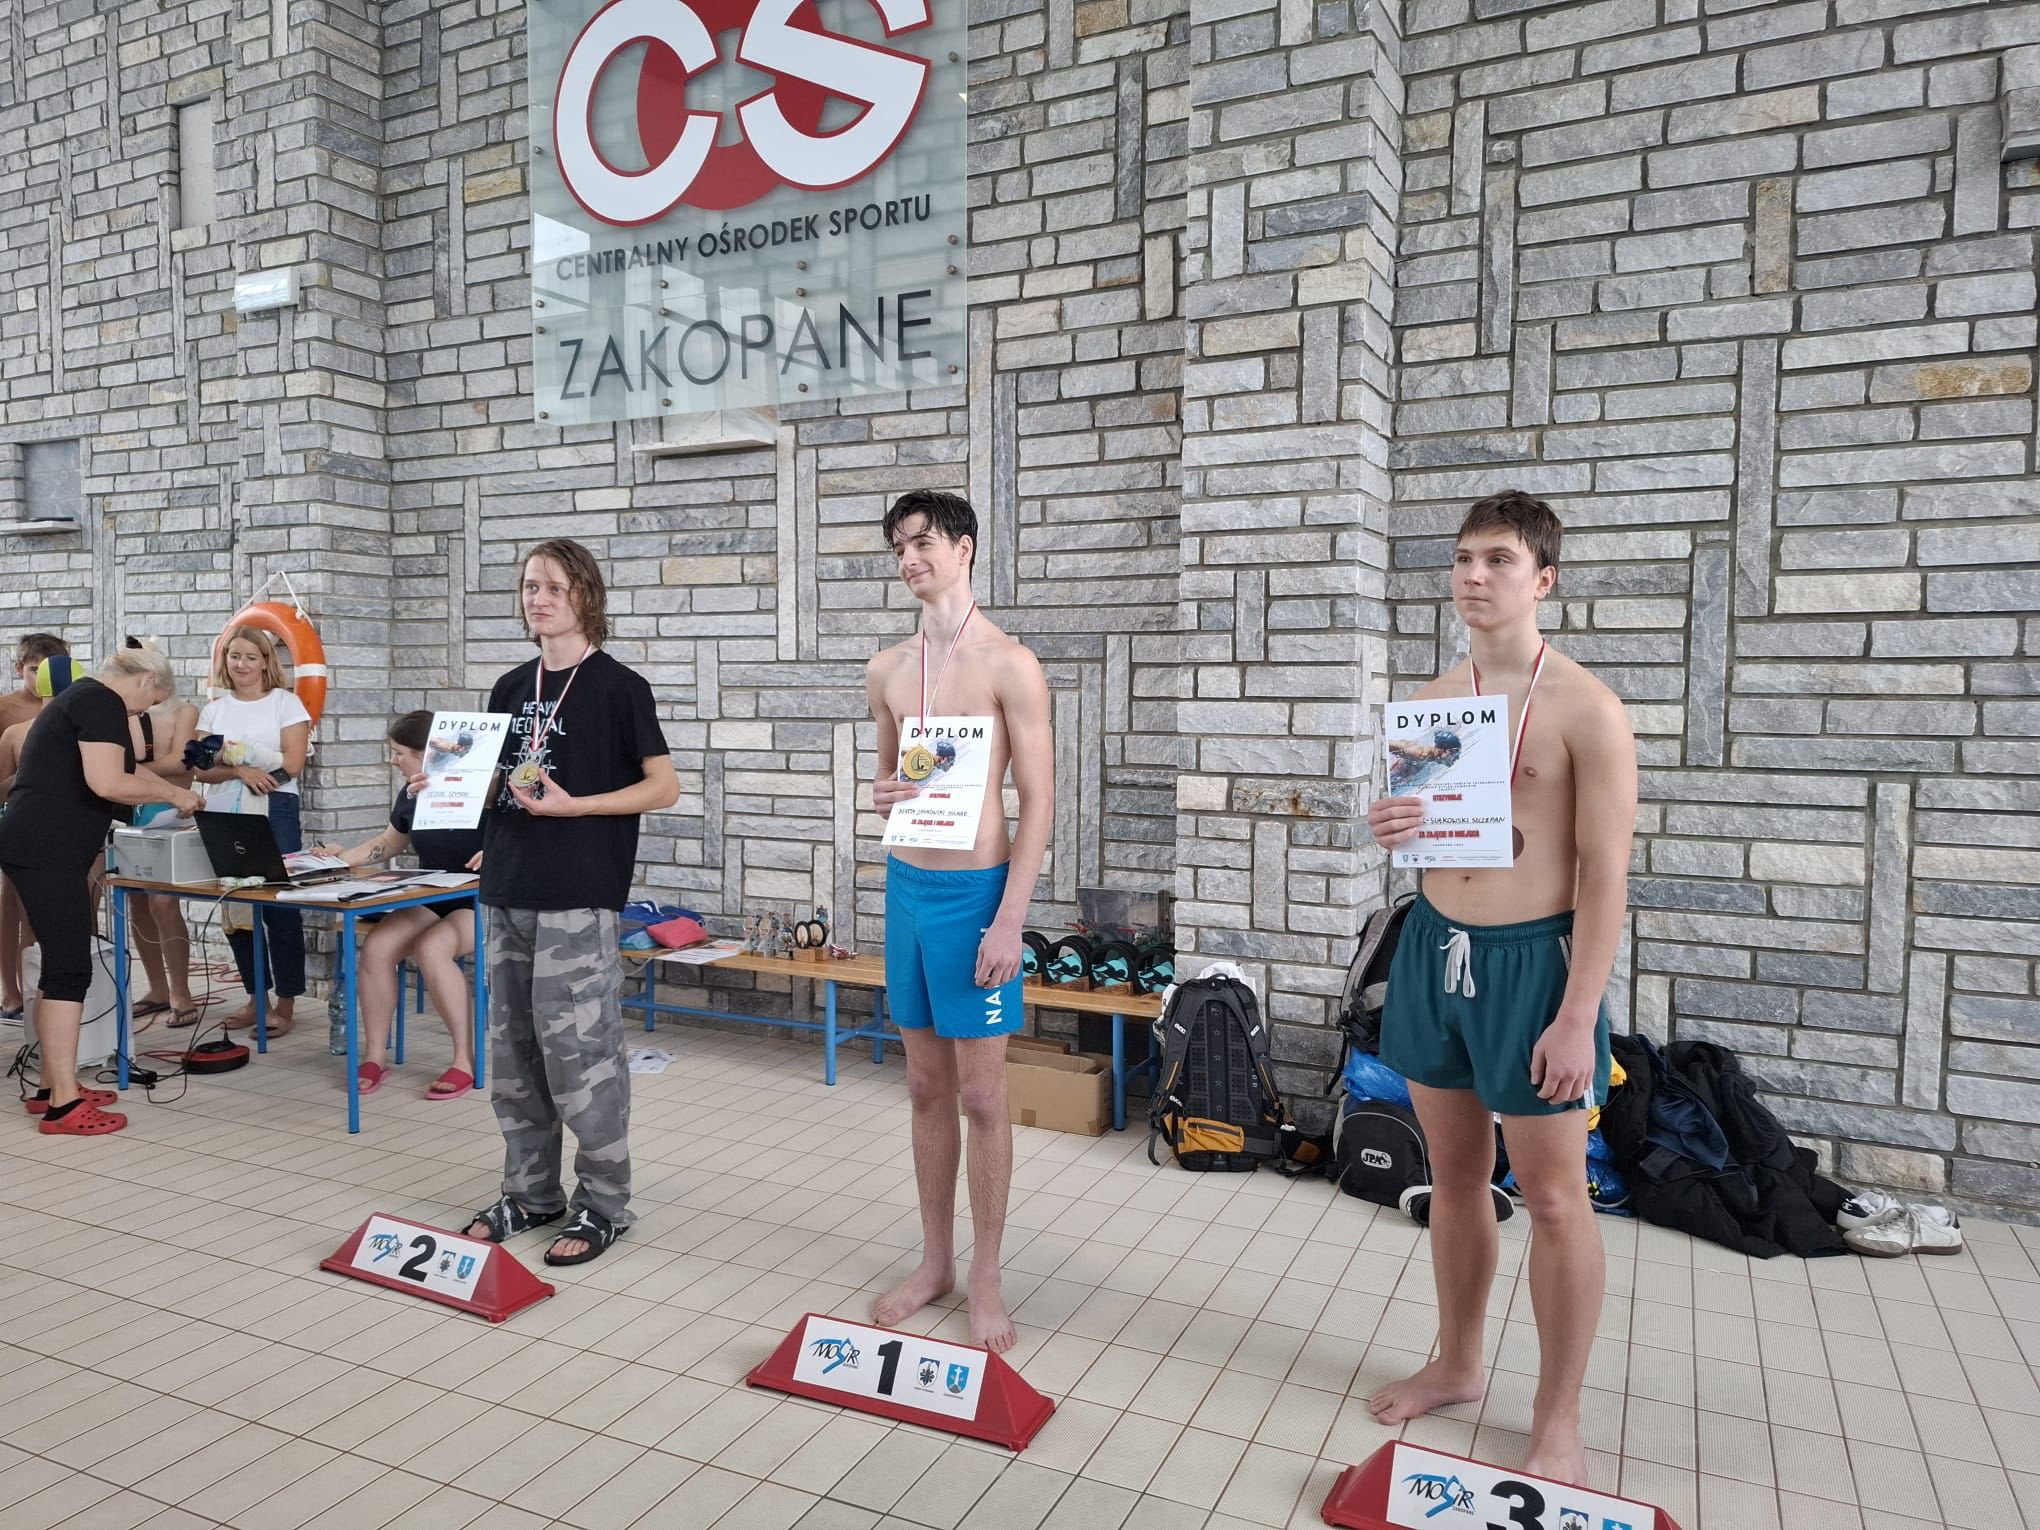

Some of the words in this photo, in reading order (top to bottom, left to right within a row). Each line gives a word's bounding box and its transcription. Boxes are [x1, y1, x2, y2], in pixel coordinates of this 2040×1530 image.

[556, 237, 690, 281] CENTRALNY
[699, 214, 820, 258] OŚRODEK
[829, 194, 932, 237] SPORTU
[558, 289, 933, 401] ZAKOPANE
[438, 720, 502, 732] DYPLOM
[911, 727, 984, 739] DYPLOM
[1397, 709, 1496, 729] DYPLOM
[398, 1234, 437, 1283] 2
[877, 1340, 904, 1396] 1
[1486, 1480, 1546, 1530] 3
